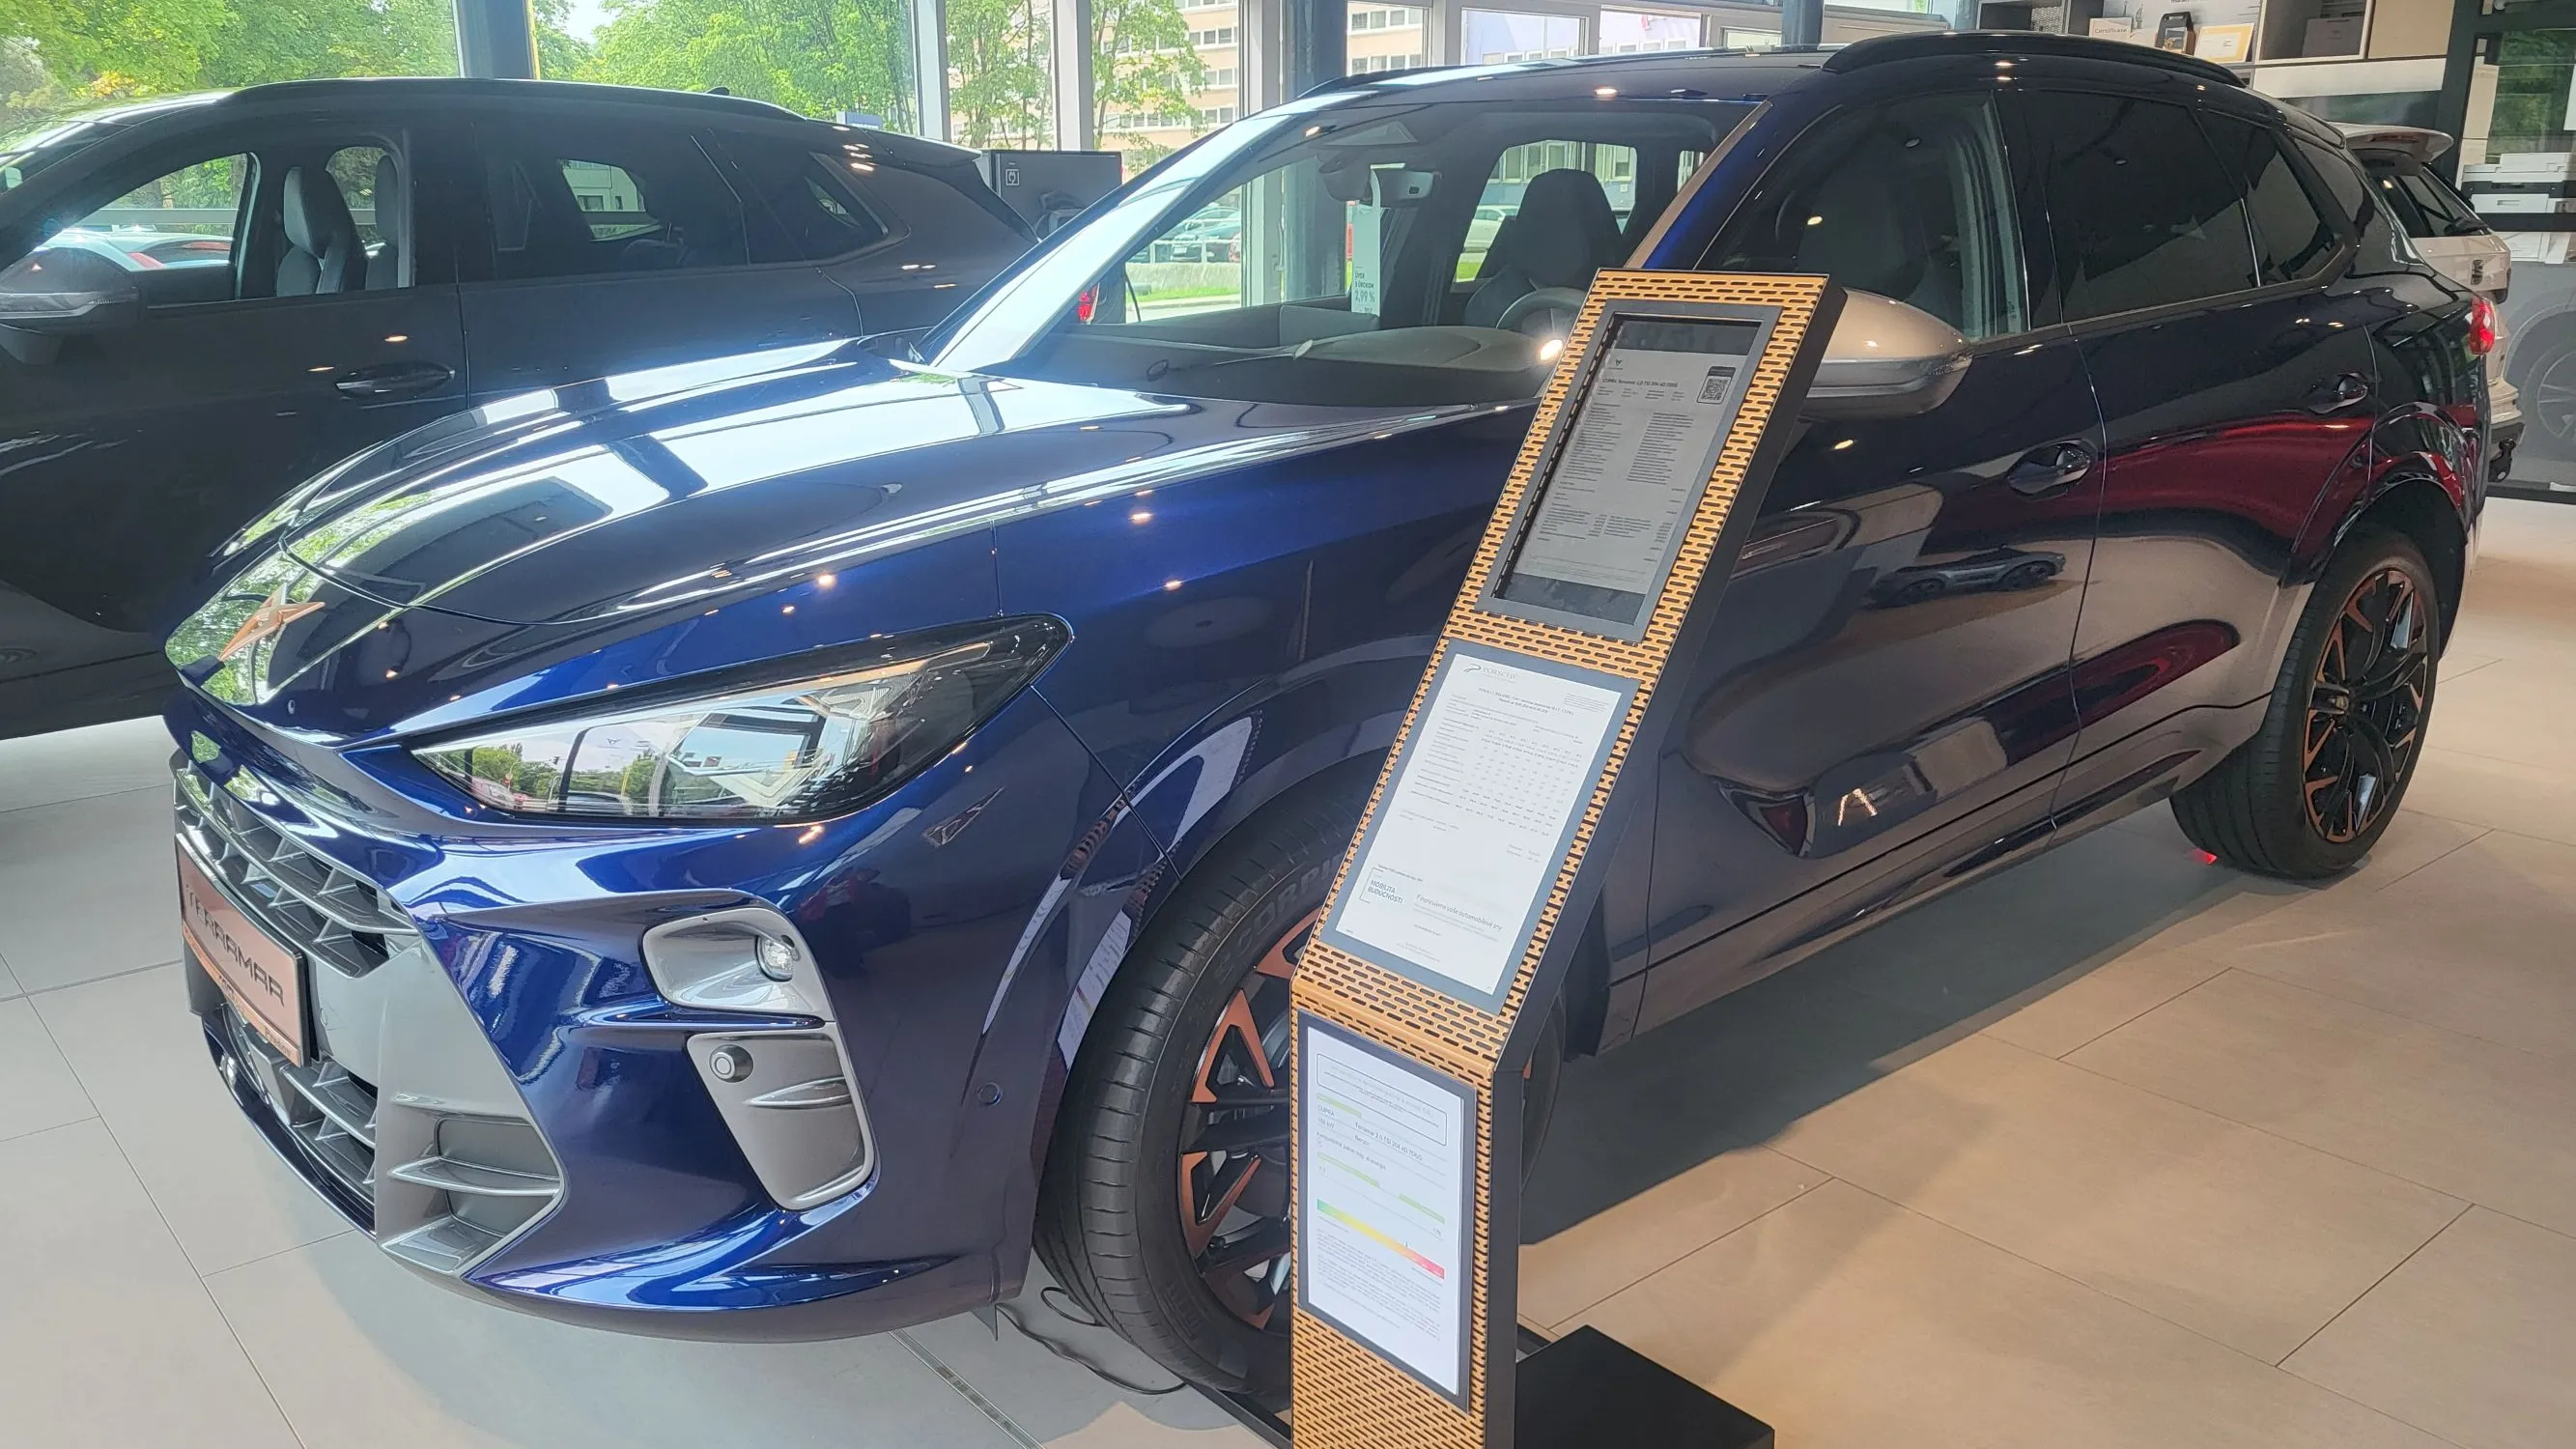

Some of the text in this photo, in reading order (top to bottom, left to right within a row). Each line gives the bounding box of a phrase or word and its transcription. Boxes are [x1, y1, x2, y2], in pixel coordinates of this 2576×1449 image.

[1354, 290, 1369, 303] 2,99
[1371, 879, 1396, 895] MOBILITA
[185, 884, 285, 1007] TERRAMAR
